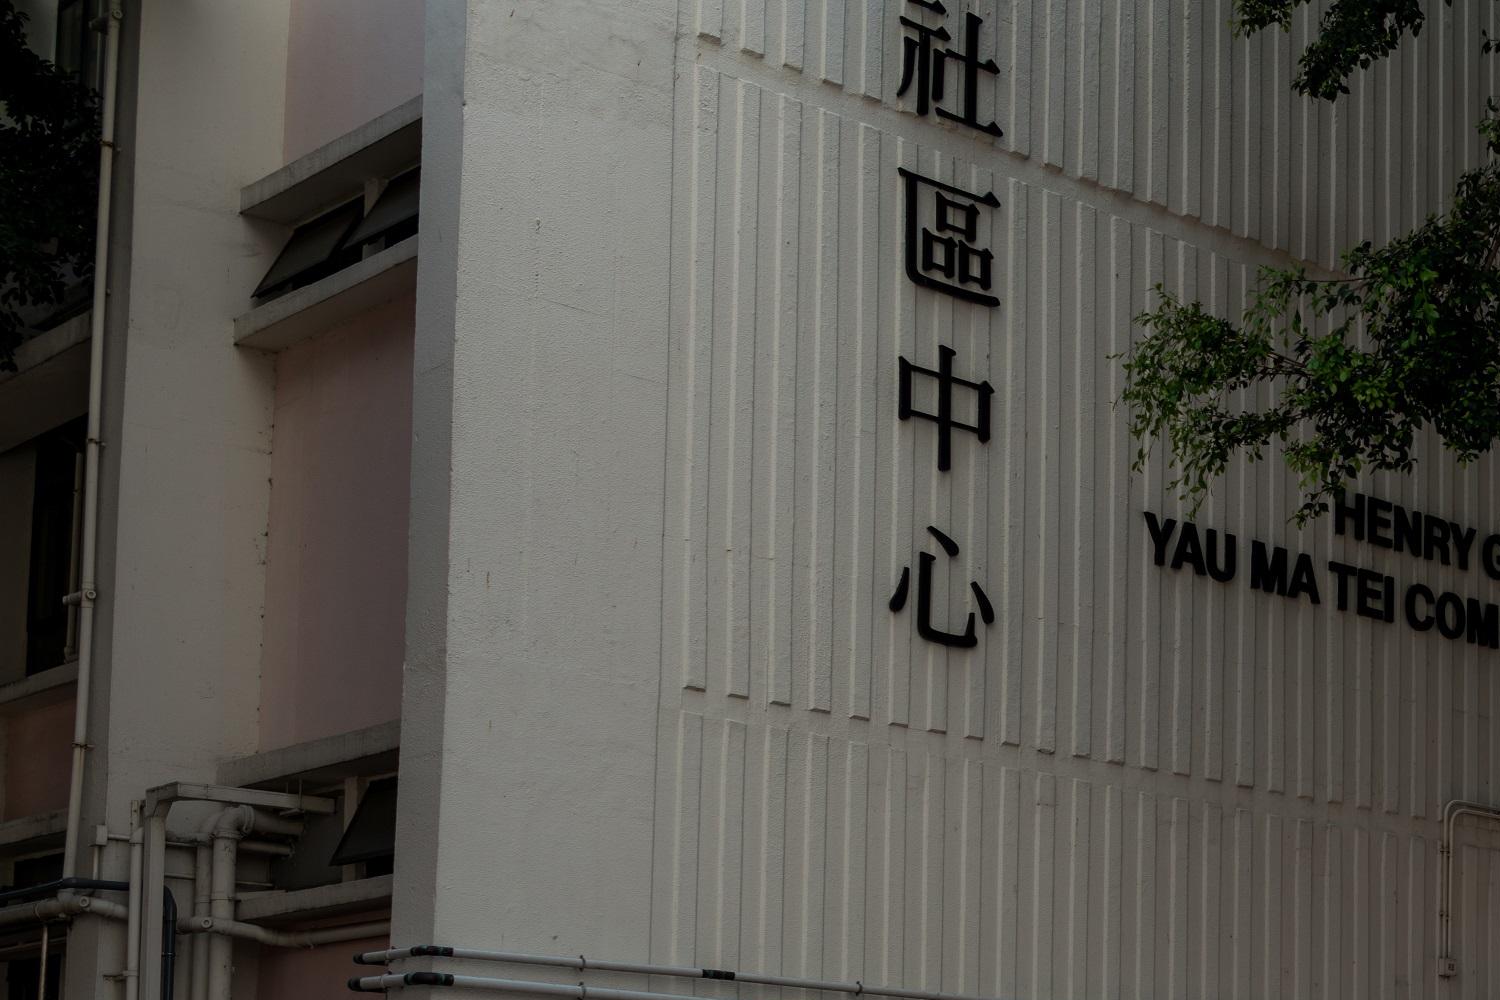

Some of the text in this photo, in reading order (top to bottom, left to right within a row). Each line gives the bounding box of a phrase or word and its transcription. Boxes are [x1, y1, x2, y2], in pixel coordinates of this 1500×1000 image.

[1143, 511, 1237, 583] YAU
[1250, 539, 1321, 605] MA
[1328, 560, 1395, 624] TEI
[1334, 489, 1477, 571] HENRY
